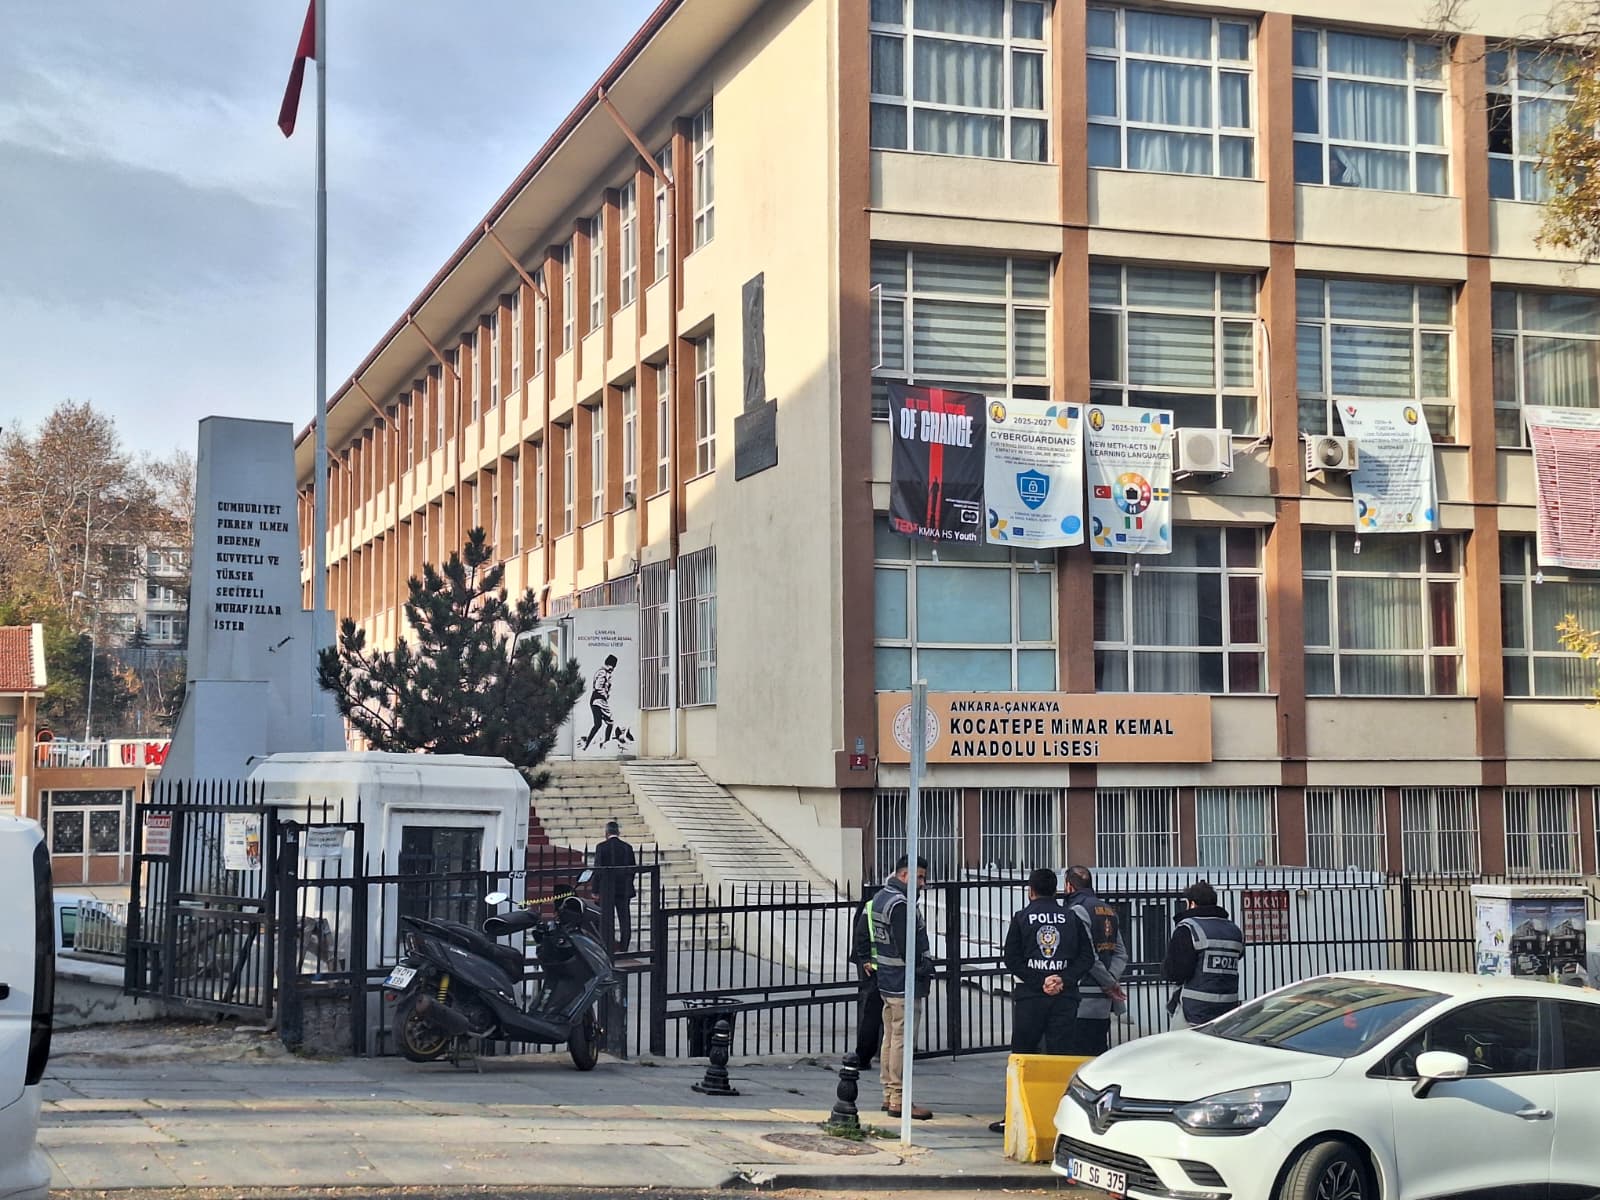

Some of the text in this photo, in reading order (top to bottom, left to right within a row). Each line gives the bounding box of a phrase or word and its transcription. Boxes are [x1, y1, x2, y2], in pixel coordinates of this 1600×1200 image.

[900, 408, 974, 448] OF CHANGE
[1013, 417, 1052, 426] 2025-2027
[1111, 424, 1147, 432] 2025-2027
[990, 431, 1076, 446] CYBERGUARDIANS
[1090, 450, 1126, 458] LEARNING
[918, 526, 940, 538] KMKA
[941, 529, 953, 539] HS
[954, 531, 977, 541] Youth
[217, 535, 261, 548] BEDENEN
[267, 555, 280, 566] VE
[216, 568, 254, 581] YÜKSEK
[215, 602, 282, 616] MUHAFIZLAR
[950, 701, 1060, 714] ANKARA-ÇANKAYA
[950, 719, 1044, 735] KOCATEPE
[1115, 719, 1174, 735] KEMAL
[950, 740, 1036, 757] ANADOLU
[856, 756, 862, 765] 2
[1027, 958, 1068, 970] ANKARA
[1073, 1161, 1124, 1191] 01 SG 375
